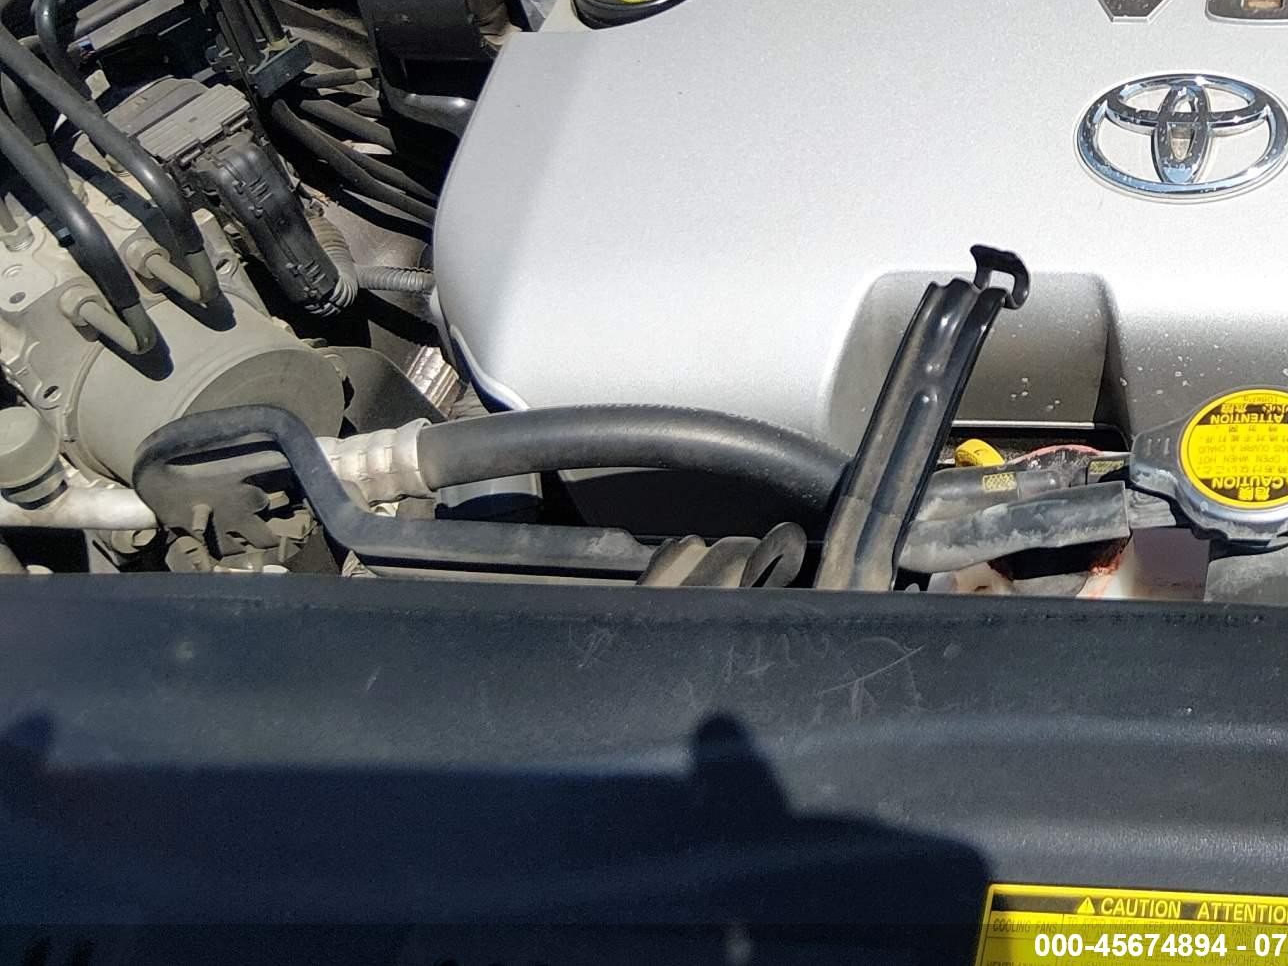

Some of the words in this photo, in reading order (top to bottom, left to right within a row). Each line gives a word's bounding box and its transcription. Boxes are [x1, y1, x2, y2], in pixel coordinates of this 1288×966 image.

[1210, 413, 1284, 424] ATTENTION
[1198, 445, 1226, 454] CHAUD
[1239, 445, 1271, 453] OUVRIR
[1199, 455, 1217, 464] HOT
[1223, 455, 1250, 463] WHEN
[1255, 455, 1281, 464] OPEN
[1212, 476, 1284, 489] CAUTION
[1101, 897, 1182, 918] CAUTION
[992, 918, 1031, 933] COOLING
[1035, 920, 1058, 934] FANS
